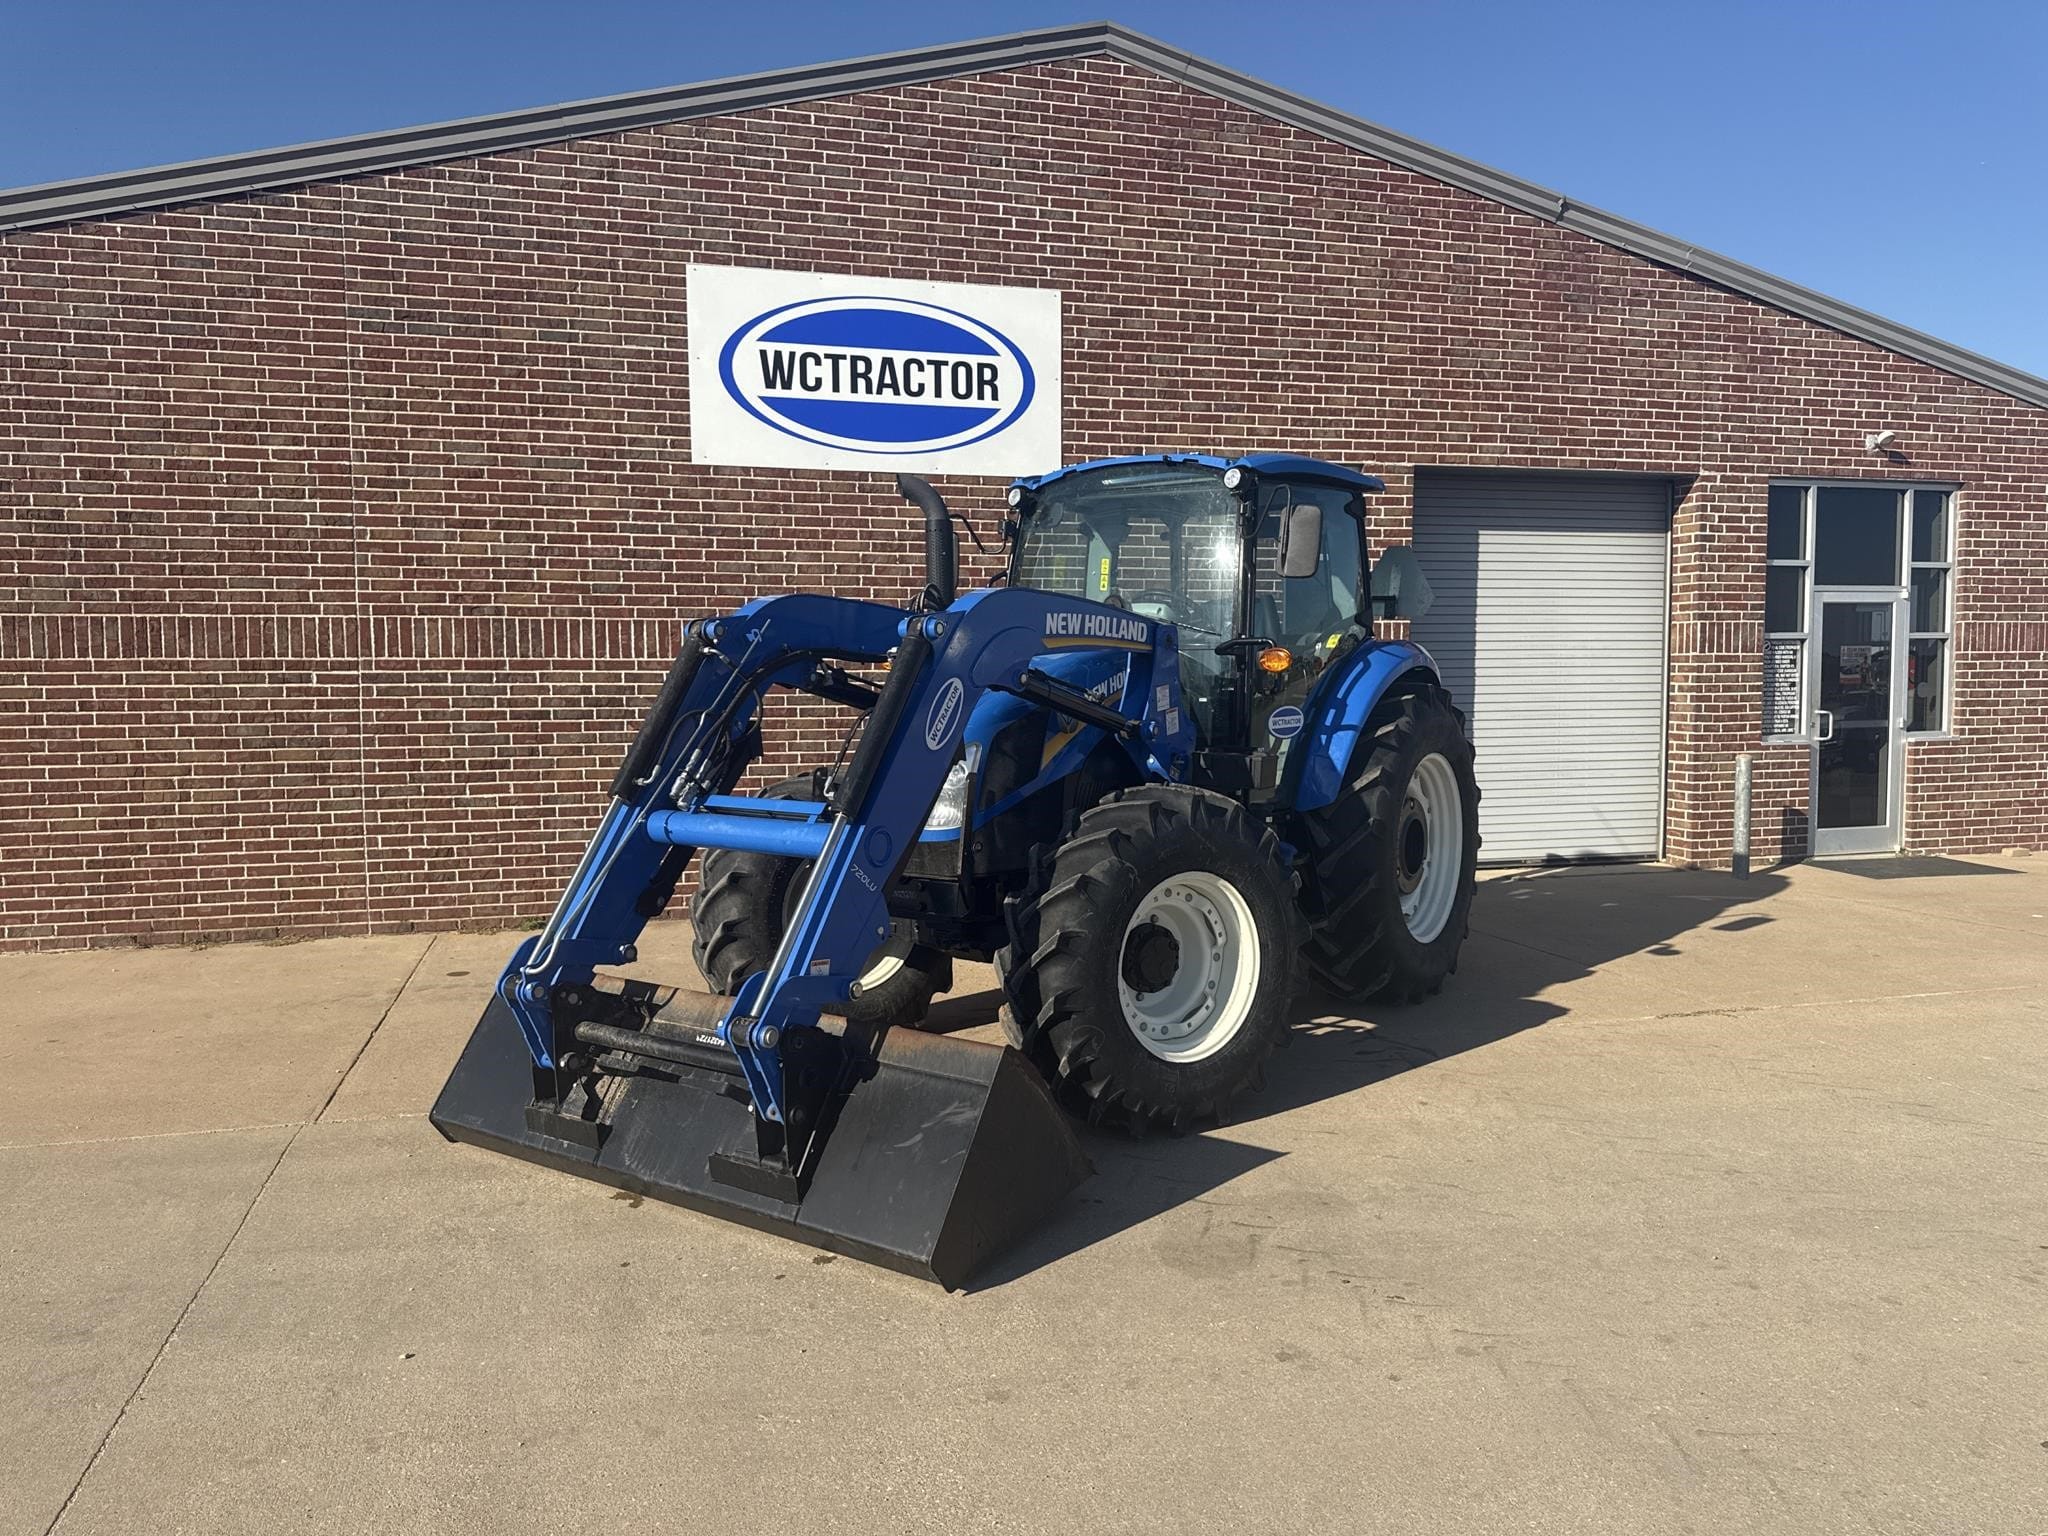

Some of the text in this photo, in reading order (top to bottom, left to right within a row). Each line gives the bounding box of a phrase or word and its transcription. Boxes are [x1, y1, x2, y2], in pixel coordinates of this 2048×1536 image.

[759, 349, 1000, 402] WCTRACTOR
[1046, 613, 1148, 643] NEW HOLLAND
[930, 685, 960, 742] WCTRACTOR
[850, 863, 878, 892] 720LU
